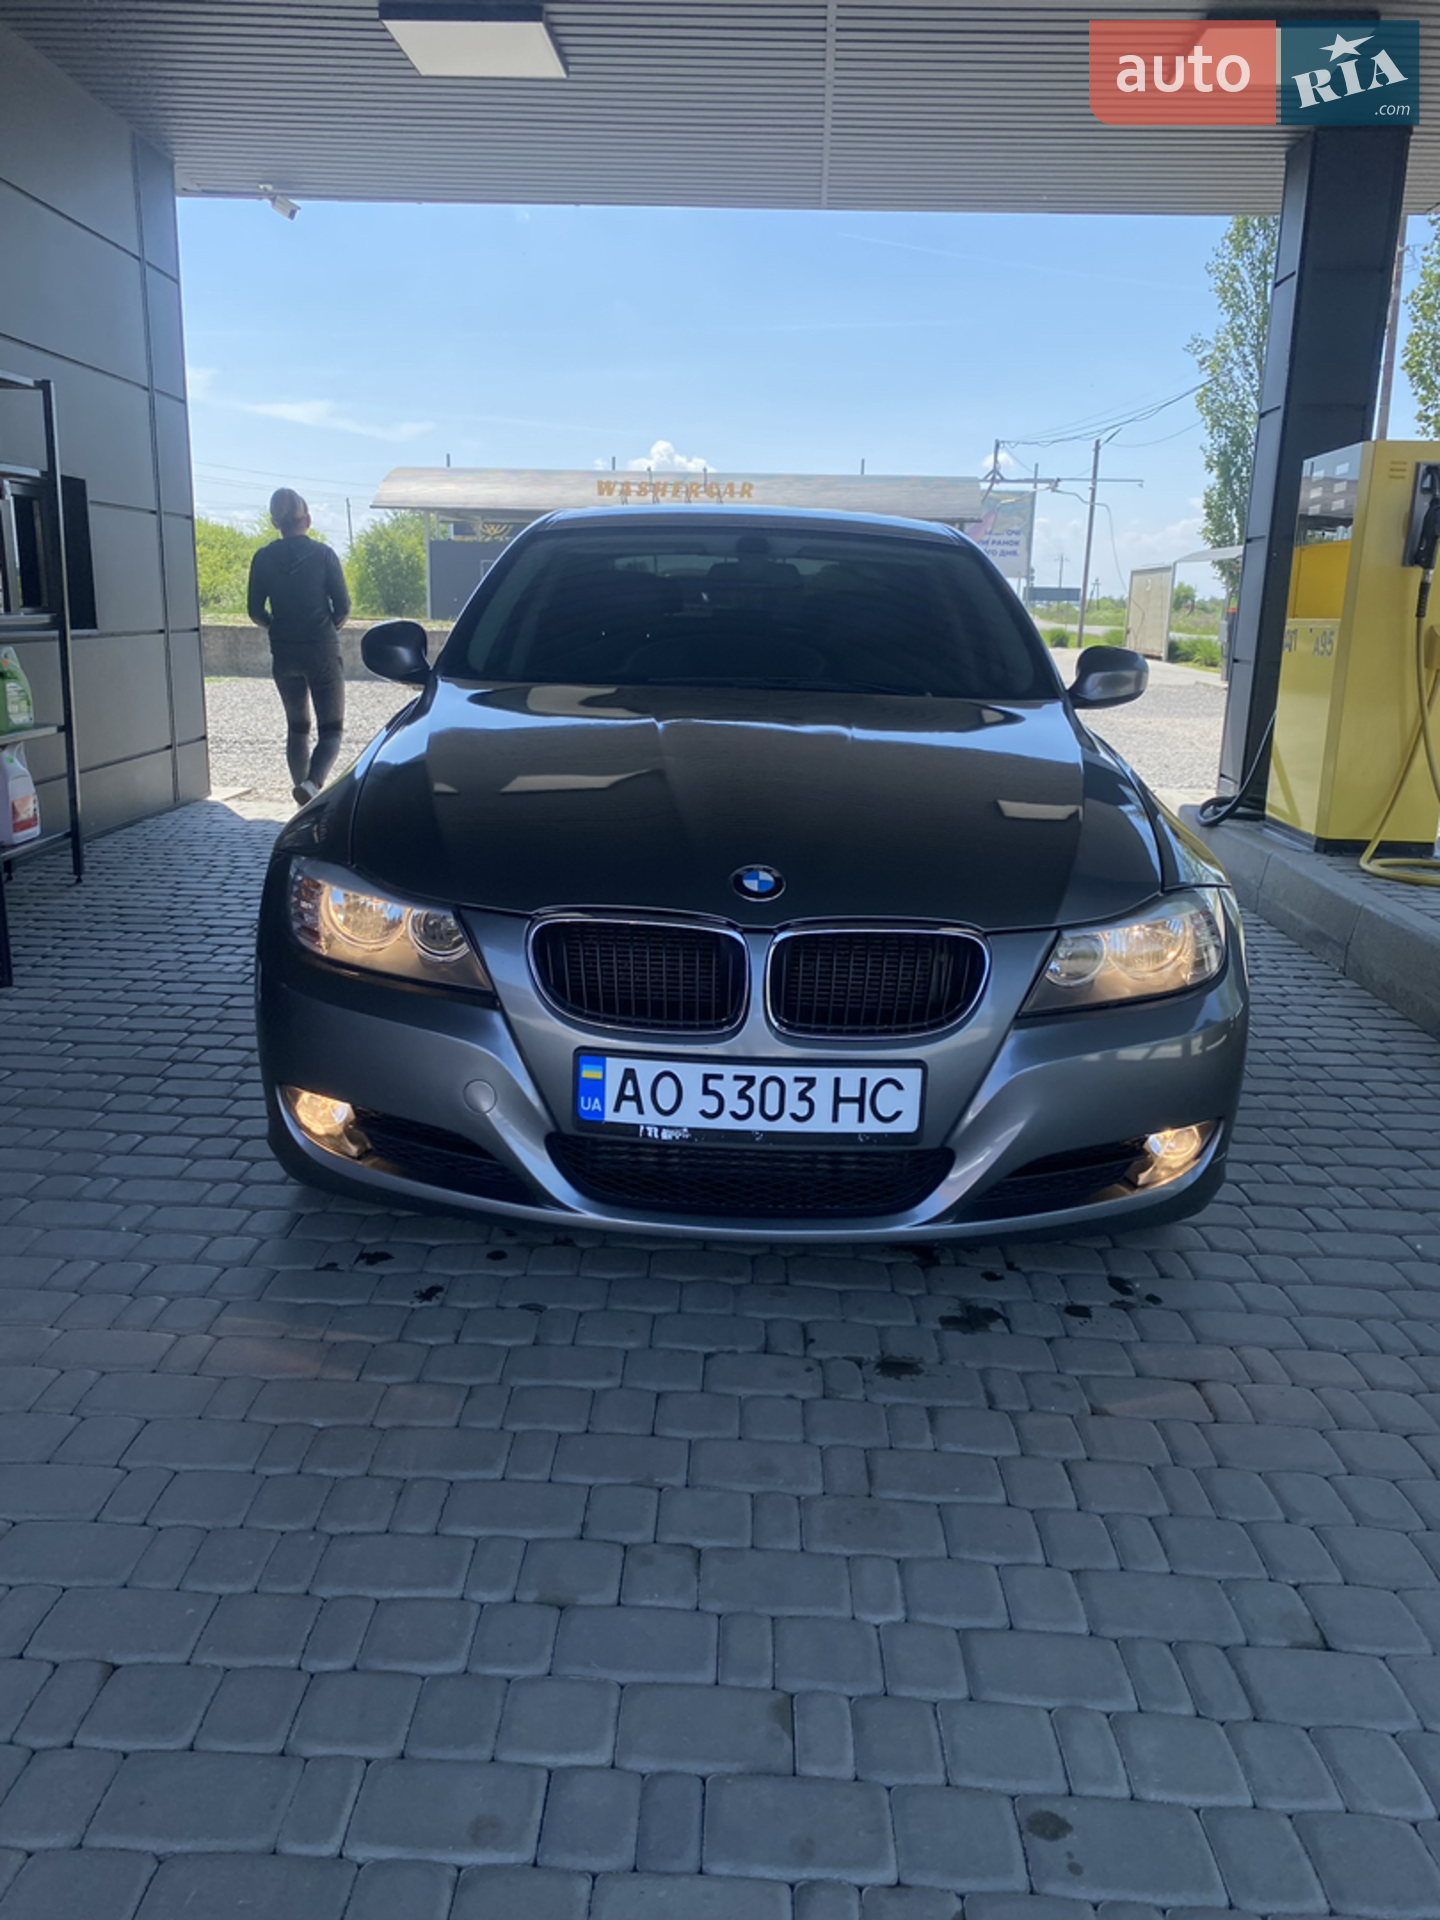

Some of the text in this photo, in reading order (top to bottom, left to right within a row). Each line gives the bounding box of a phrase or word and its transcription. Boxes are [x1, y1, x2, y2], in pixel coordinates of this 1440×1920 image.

[580, 1097, 602, 1113] UA
[613, 1067, 905, 1124] AO 5303 HC
